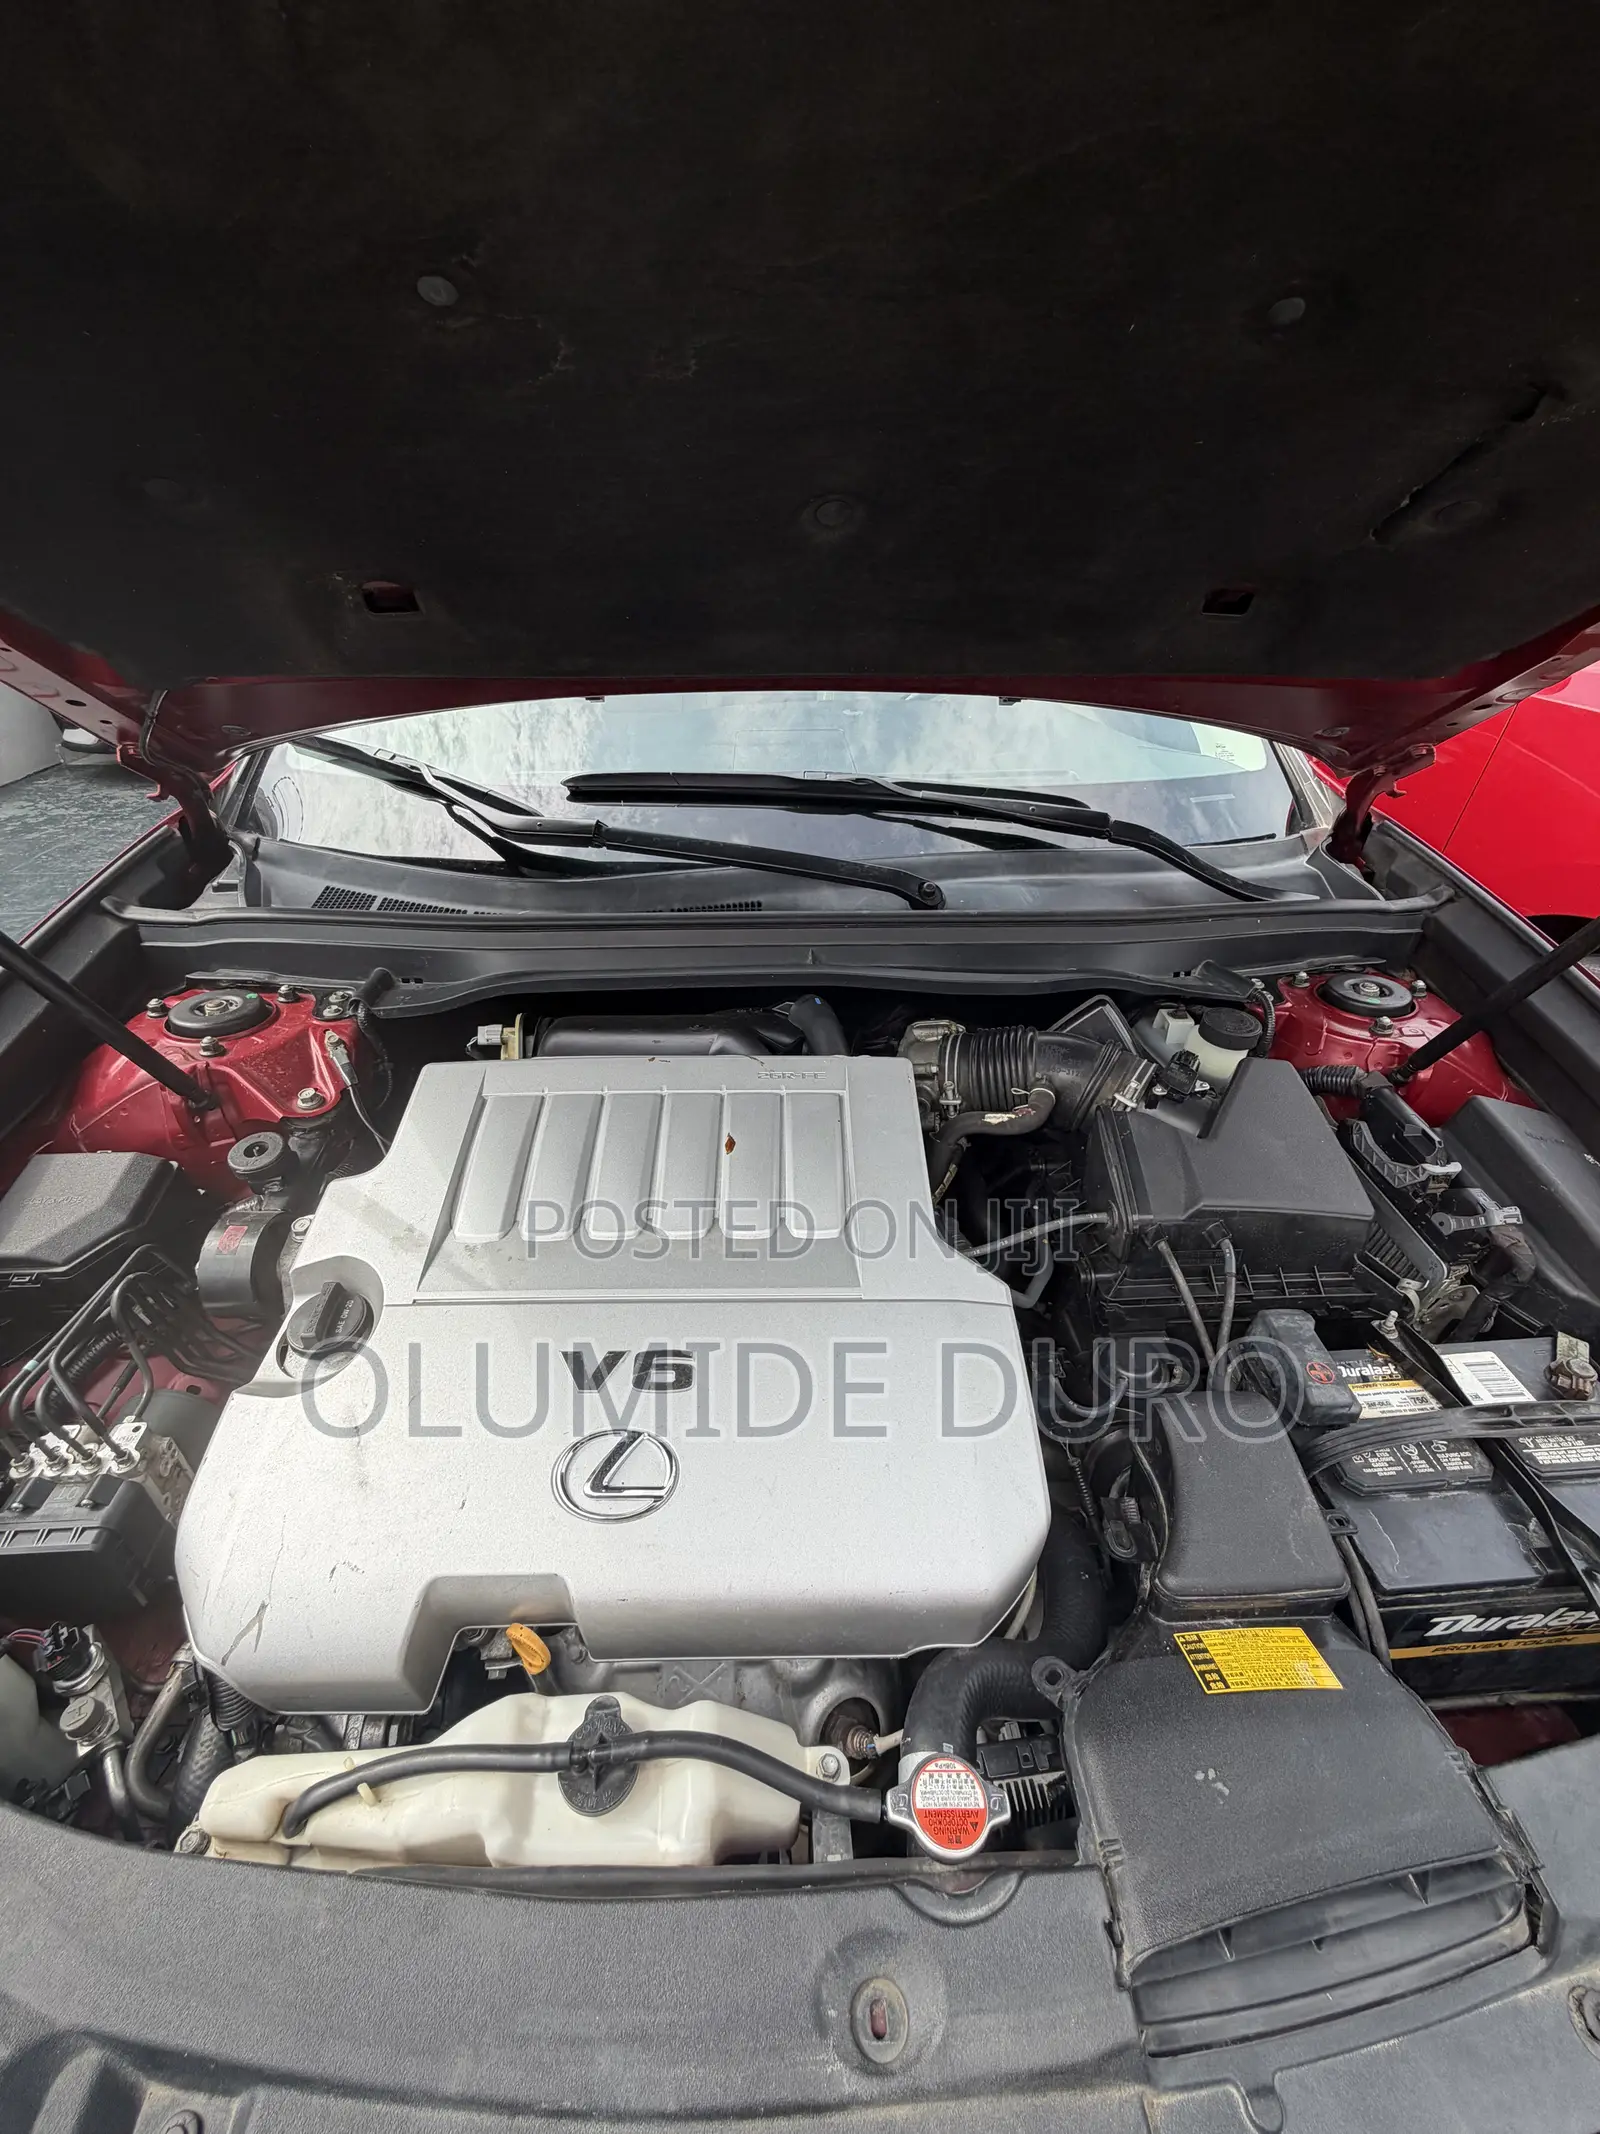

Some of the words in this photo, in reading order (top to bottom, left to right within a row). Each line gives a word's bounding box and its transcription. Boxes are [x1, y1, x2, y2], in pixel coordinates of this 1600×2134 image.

[335, 1320, 346, 1333] SAE
[559, 1349, 697, 1394] V6
[1337, 1362, 1399, 1378] Duralast
[1410, 1396, 1429, 1404] 750
[1424, 1607, 1600, 1637] Duralas
[1182, 1642, 1206, 1651] CAUTION
[1432, 1641, 1508, 1653] PROVEN
[1514, 1636, 1578, 1647] TOUGH
[934, 1762, 957, 1770] 108kPa
[924, 1810, 979, 1819] AVERTISSEMENT
[933, 1826, 970, 1835] WARNING
